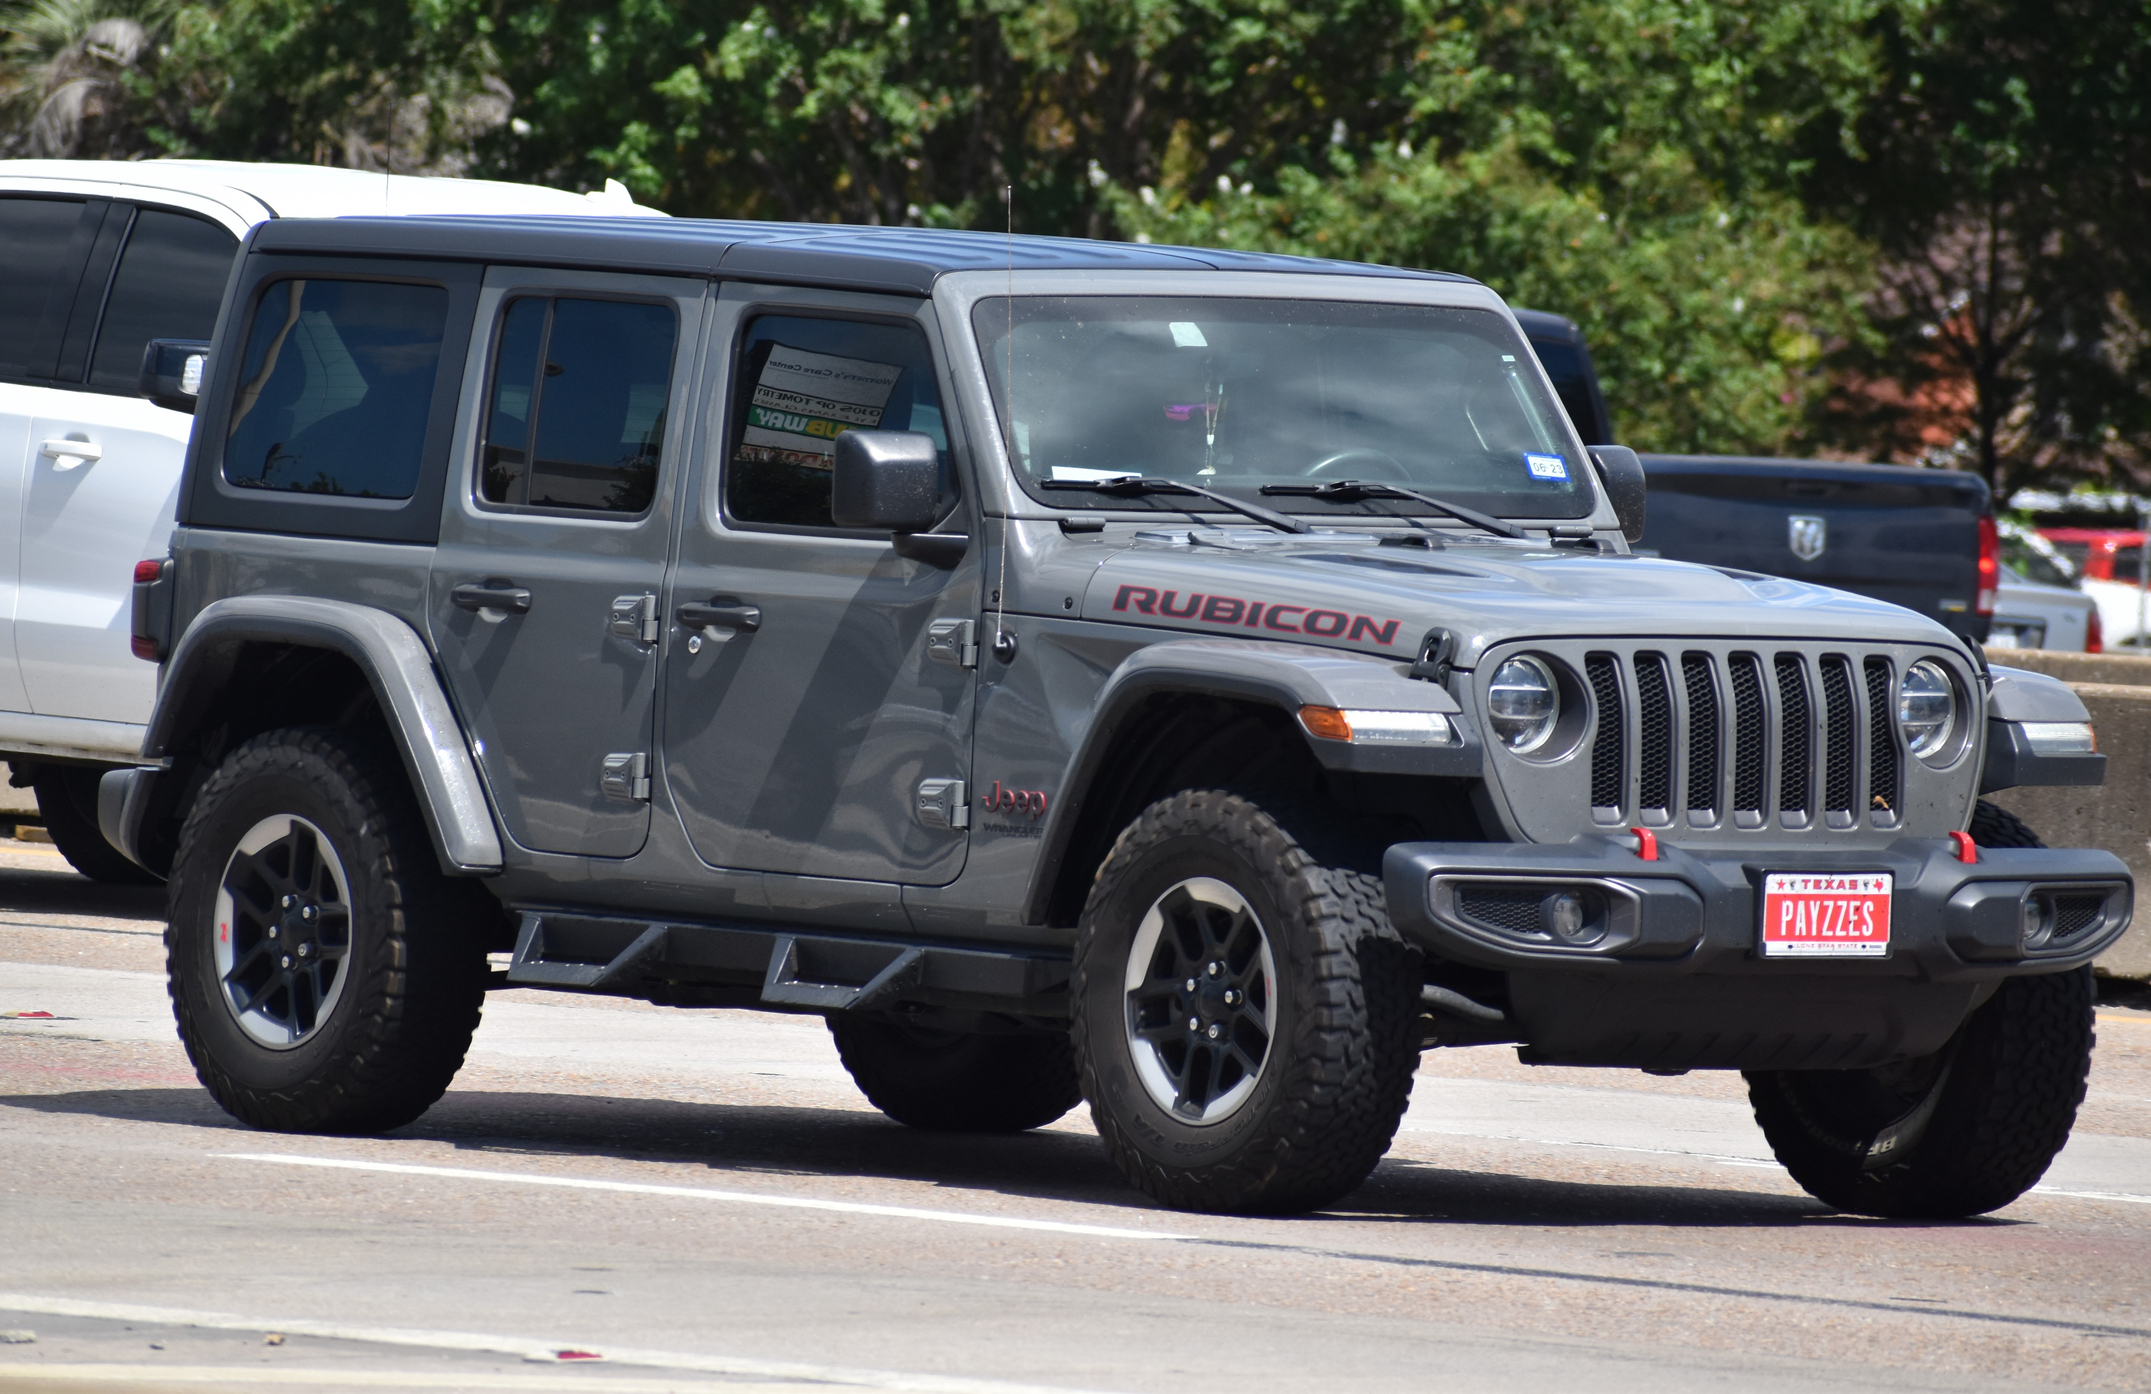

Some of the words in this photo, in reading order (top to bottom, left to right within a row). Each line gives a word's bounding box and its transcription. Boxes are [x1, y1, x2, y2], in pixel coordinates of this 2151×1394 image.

[1112, 584, 1402, 646] RUBICON
[981, 780, 1047, 822] Jeep
[983, 823, 1044, 835] WRANGLER
[1802, 879, 1858, 890] TEXAS
[1781, 900, 1874, 936] PAYZZES
